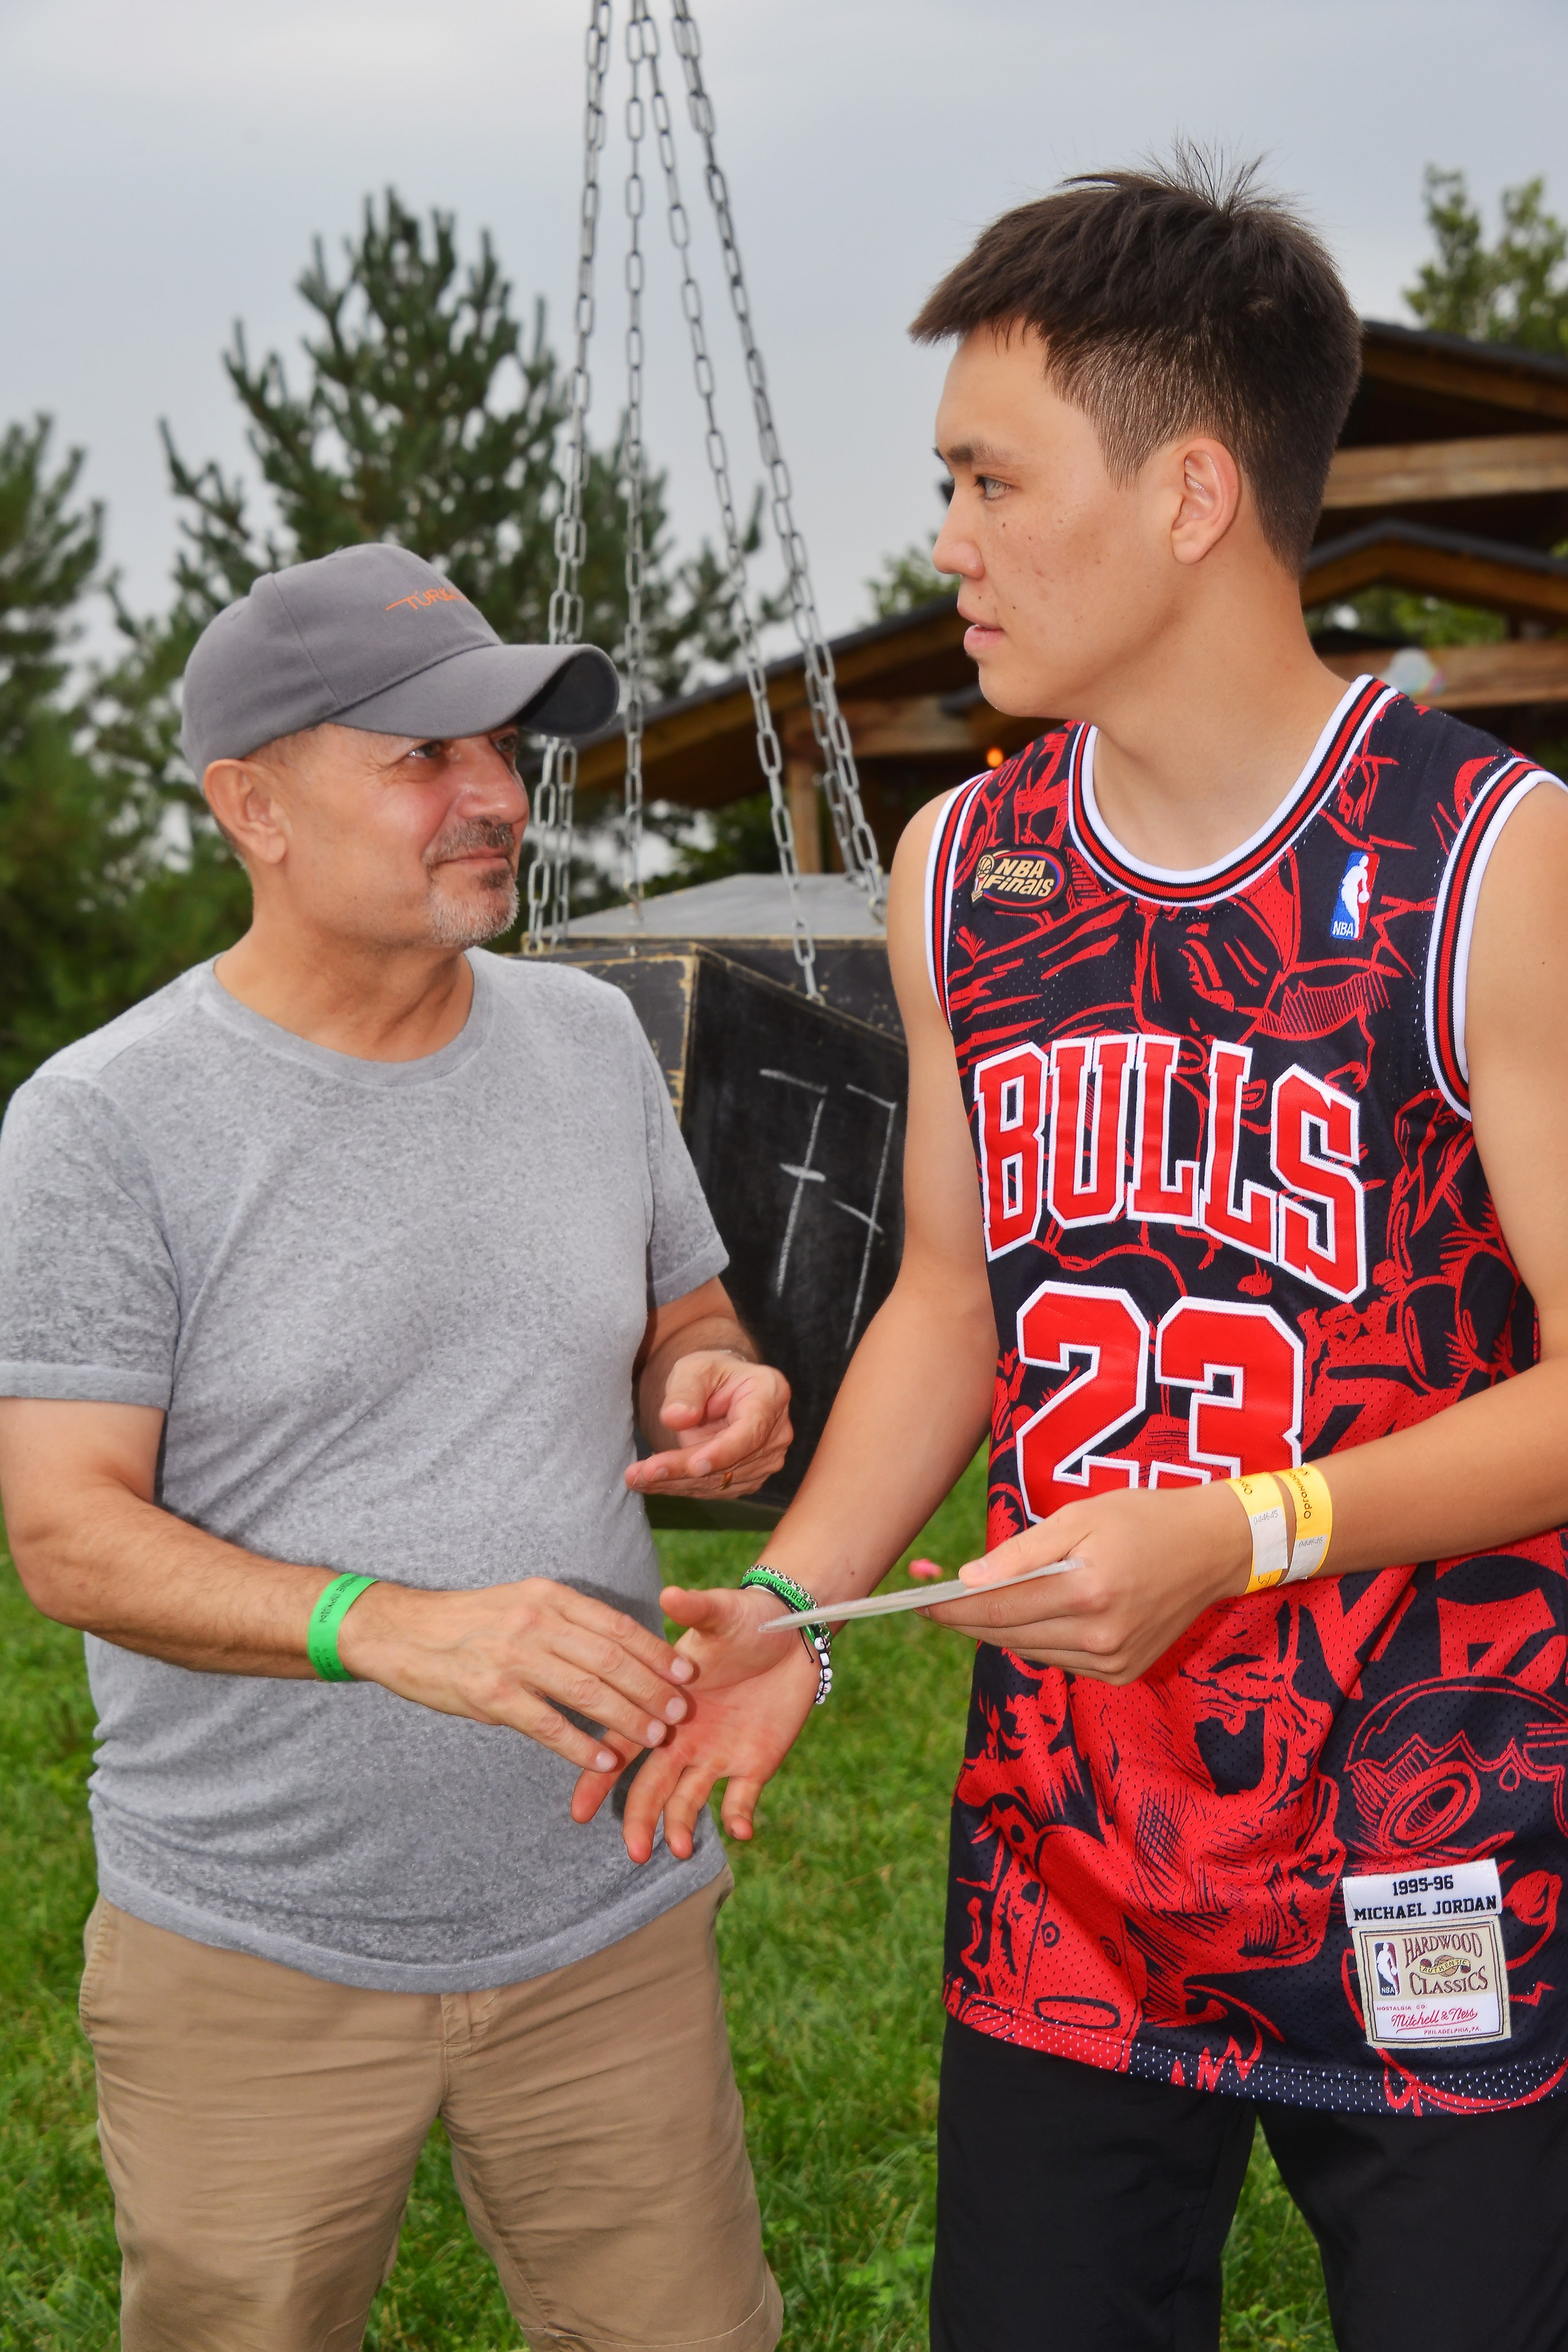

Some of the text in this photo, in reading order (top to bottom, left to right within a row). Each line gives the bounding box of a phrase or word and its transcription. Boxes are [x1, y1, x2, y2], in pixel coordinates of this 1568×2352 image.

[994, 858, 1046, 878] NBA
[982, 874, 1054, 897] Finals
[1332, 920, 1354, 937] NBA
[974, 1033, 1366, 1302] BULLS
[1016, 1280, 1303, 1523] 23
[1253, 1510, 1278, 1525] 044645
[1392, 1875, 1454, 1896] 1995-96
[1354, 1895, 1497, 1921] MICHAEL JORDAN
[1402, 1932, 1482, 1969] HARDWOOD
[1422, 1960, 1467, 1973] AUTHENTIC
[1409, 1965, 1488, 1996] CLASSICS
[1391, 2007, 1477, 2027] Mitchell & Ness
